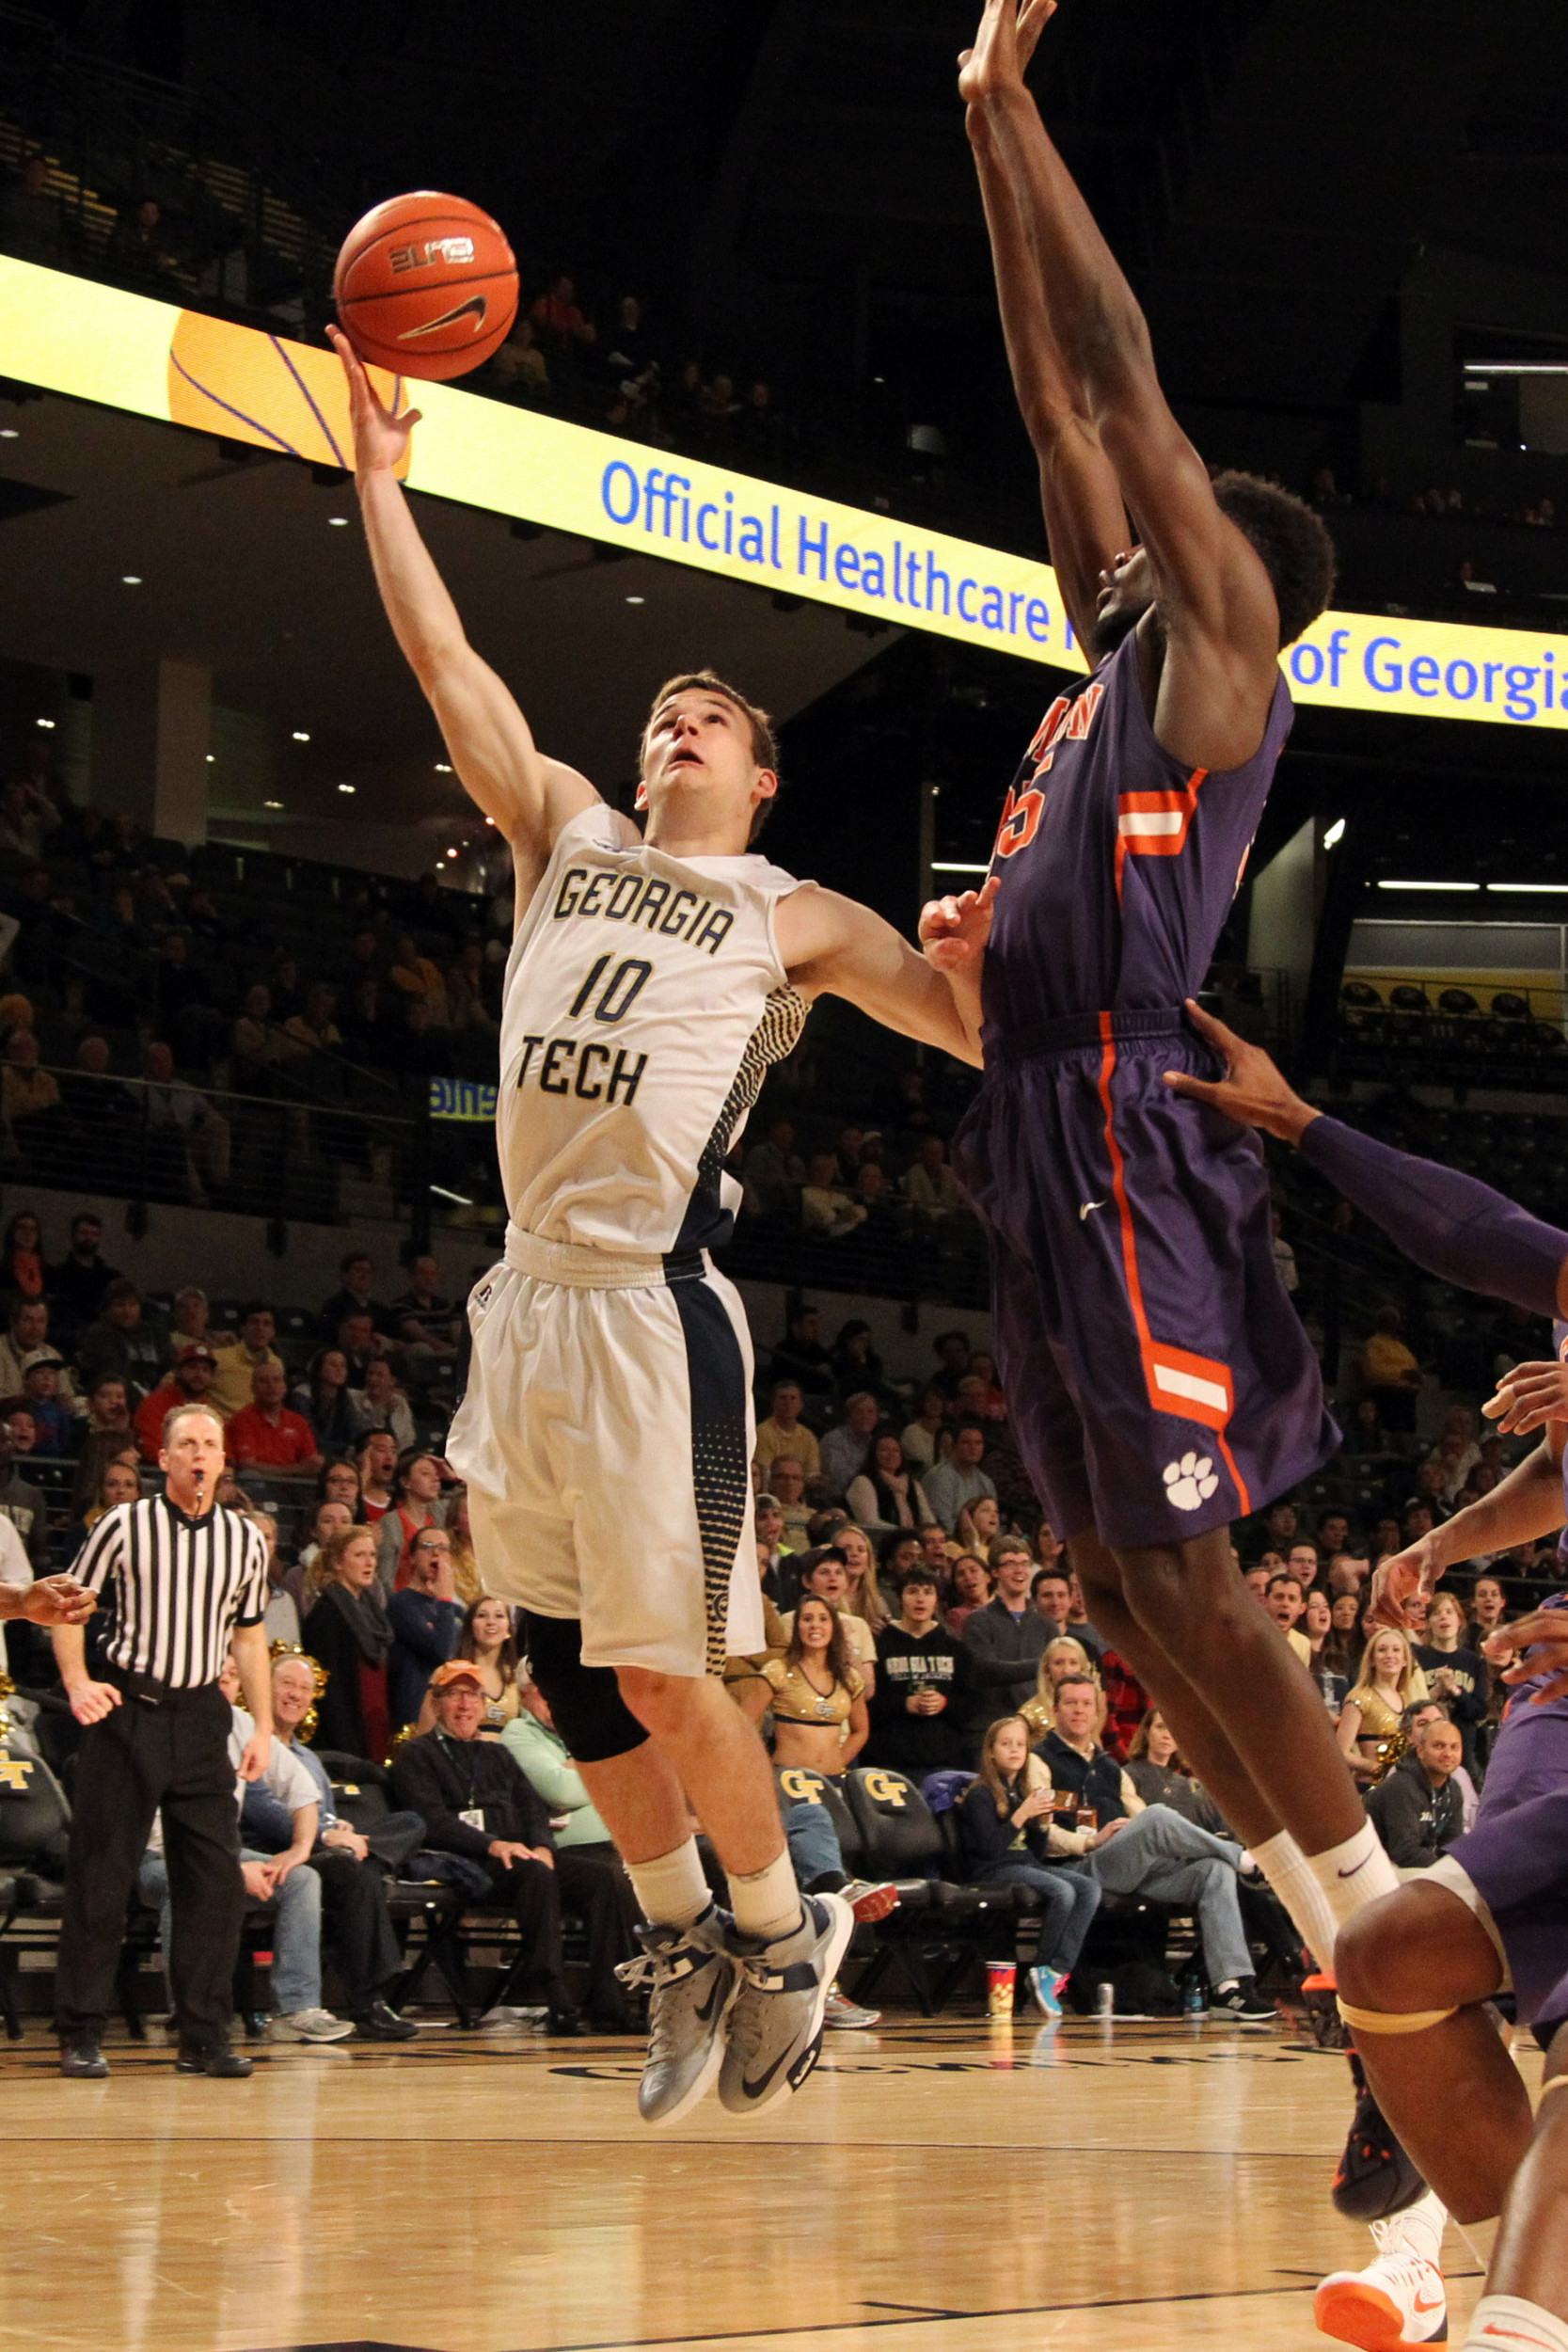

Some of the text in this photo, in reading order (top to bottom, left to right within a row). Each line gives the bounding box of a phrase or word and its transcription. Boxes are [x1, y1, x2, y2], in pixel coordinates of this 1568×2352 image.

[602, 460, 1049, 643] Official Healthcare
[1291, 629, 1350, 688] of
[553, 867, 734, 956] GEORGIA
[565, 951, 654, 1025] 10
[517, 1035, 649, 1106] TECH
